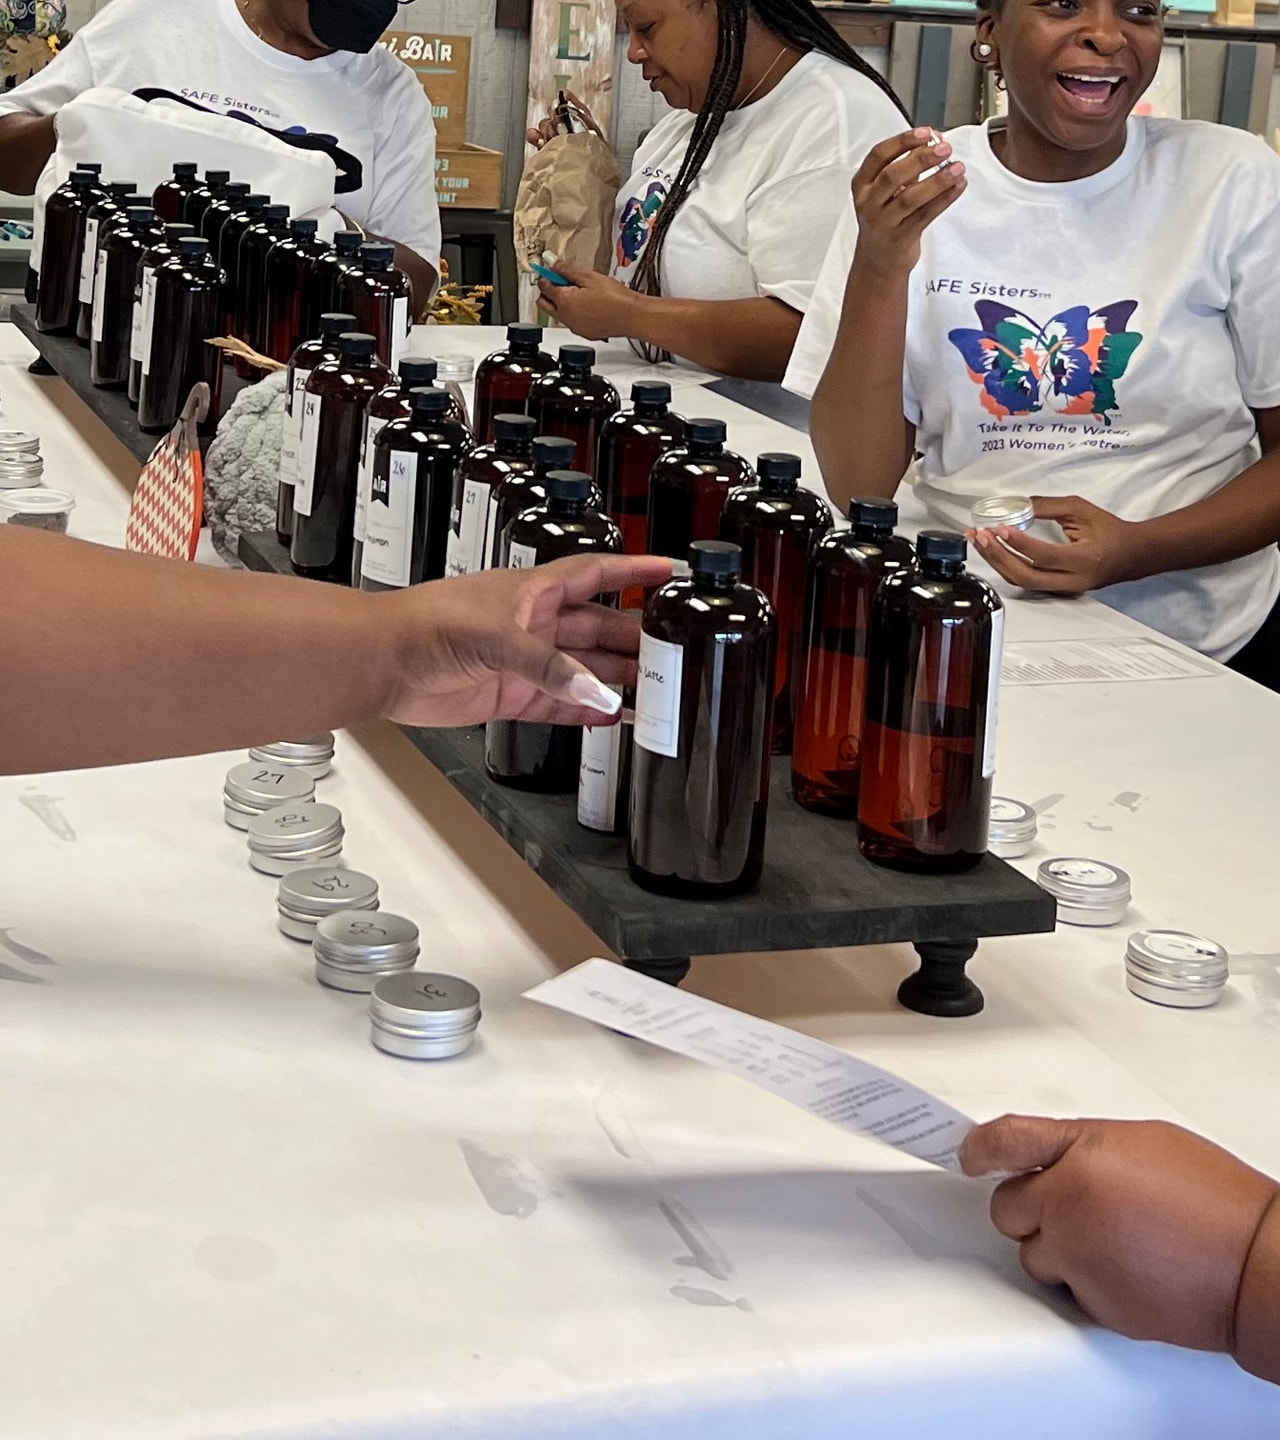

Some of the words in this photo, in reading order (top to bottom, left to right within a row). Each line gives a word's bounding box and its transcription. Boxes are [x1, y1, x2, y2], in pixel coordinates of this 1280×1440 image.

[180, 88, 219, 103] SAFE
[442, 176, 470, 189] YOUR
[978, 422, 1008, 434] Take
[1011, 423, 1023, 433] It
[1028, 423, 1045, 433] To
[1051, 423, 1077, 435] The
[981, 438, 1005, 452] 2023
